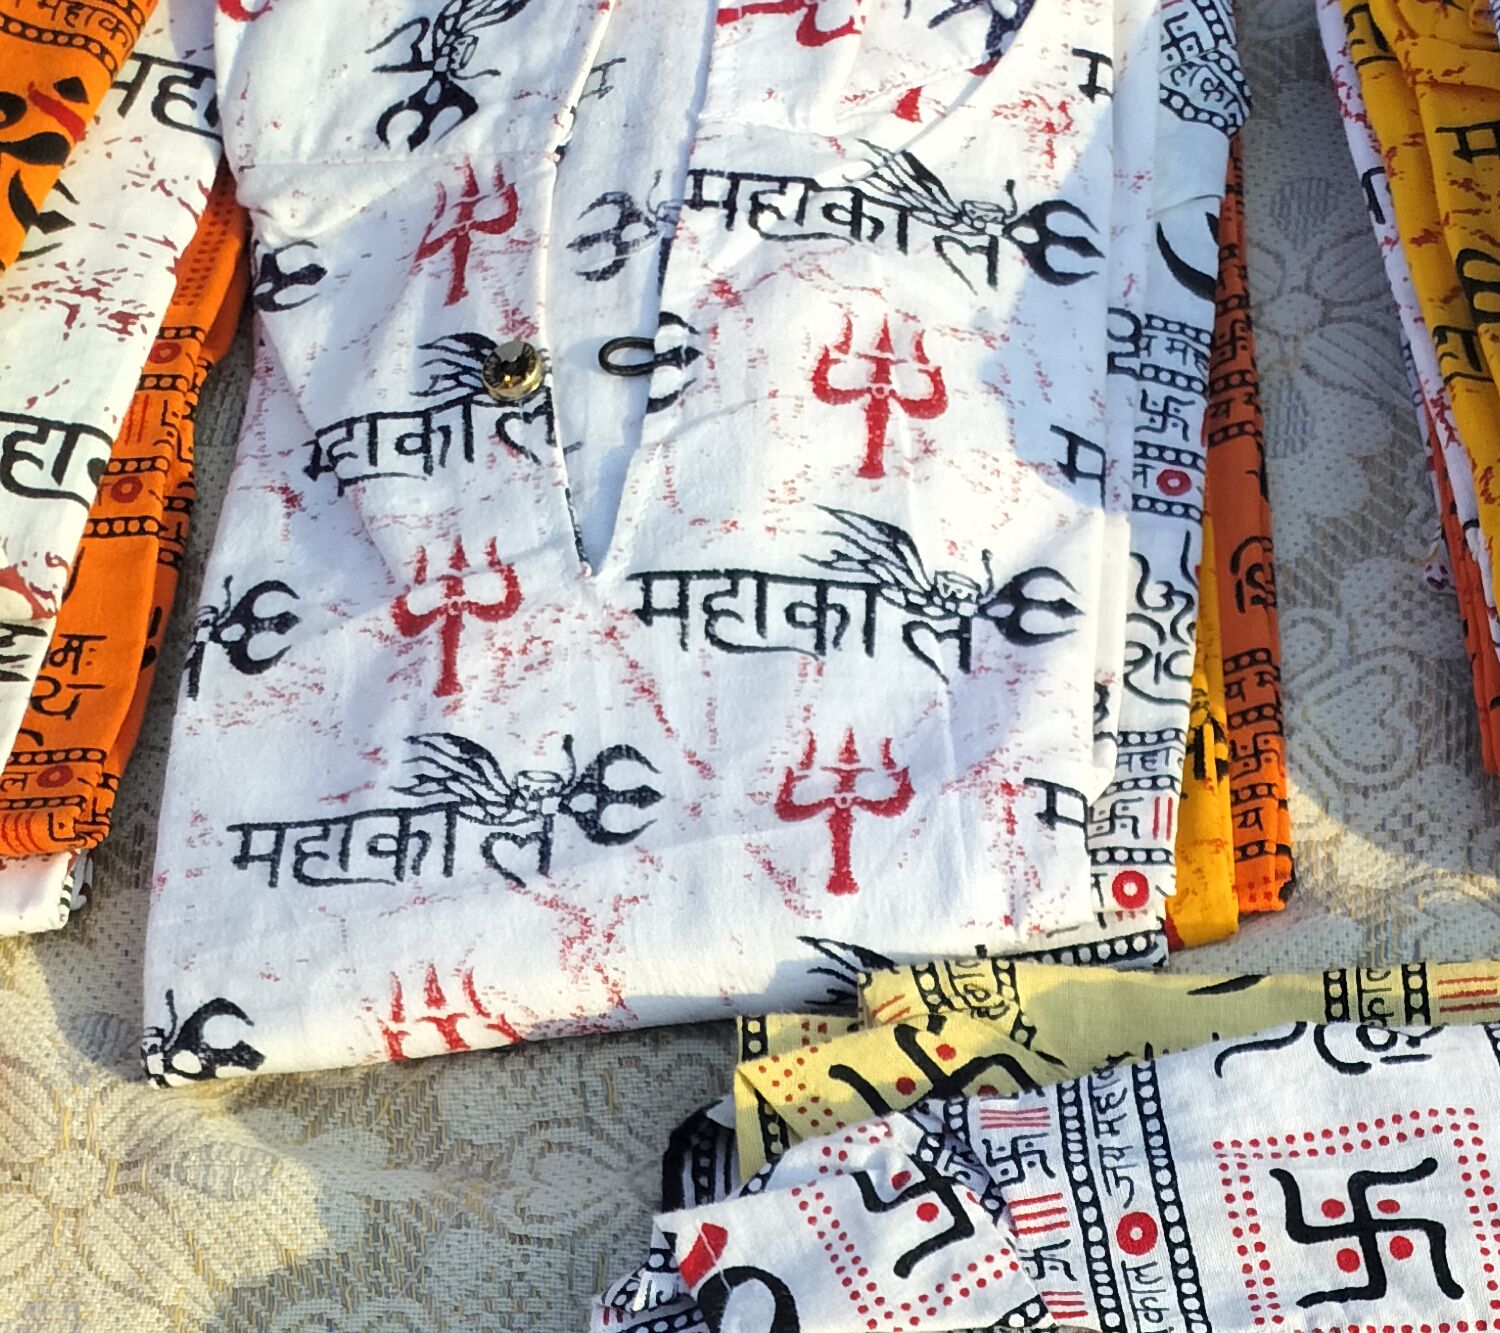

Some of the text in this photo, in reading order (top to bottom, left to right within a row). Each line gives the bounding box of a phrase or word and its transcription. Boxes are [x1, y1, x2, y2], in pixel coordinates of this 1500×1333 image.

[686, 168, 1001, 295] महाकाल
[627, 567, 973, 683] महाकाल
[226, 799, 555, 888] महाकाल
